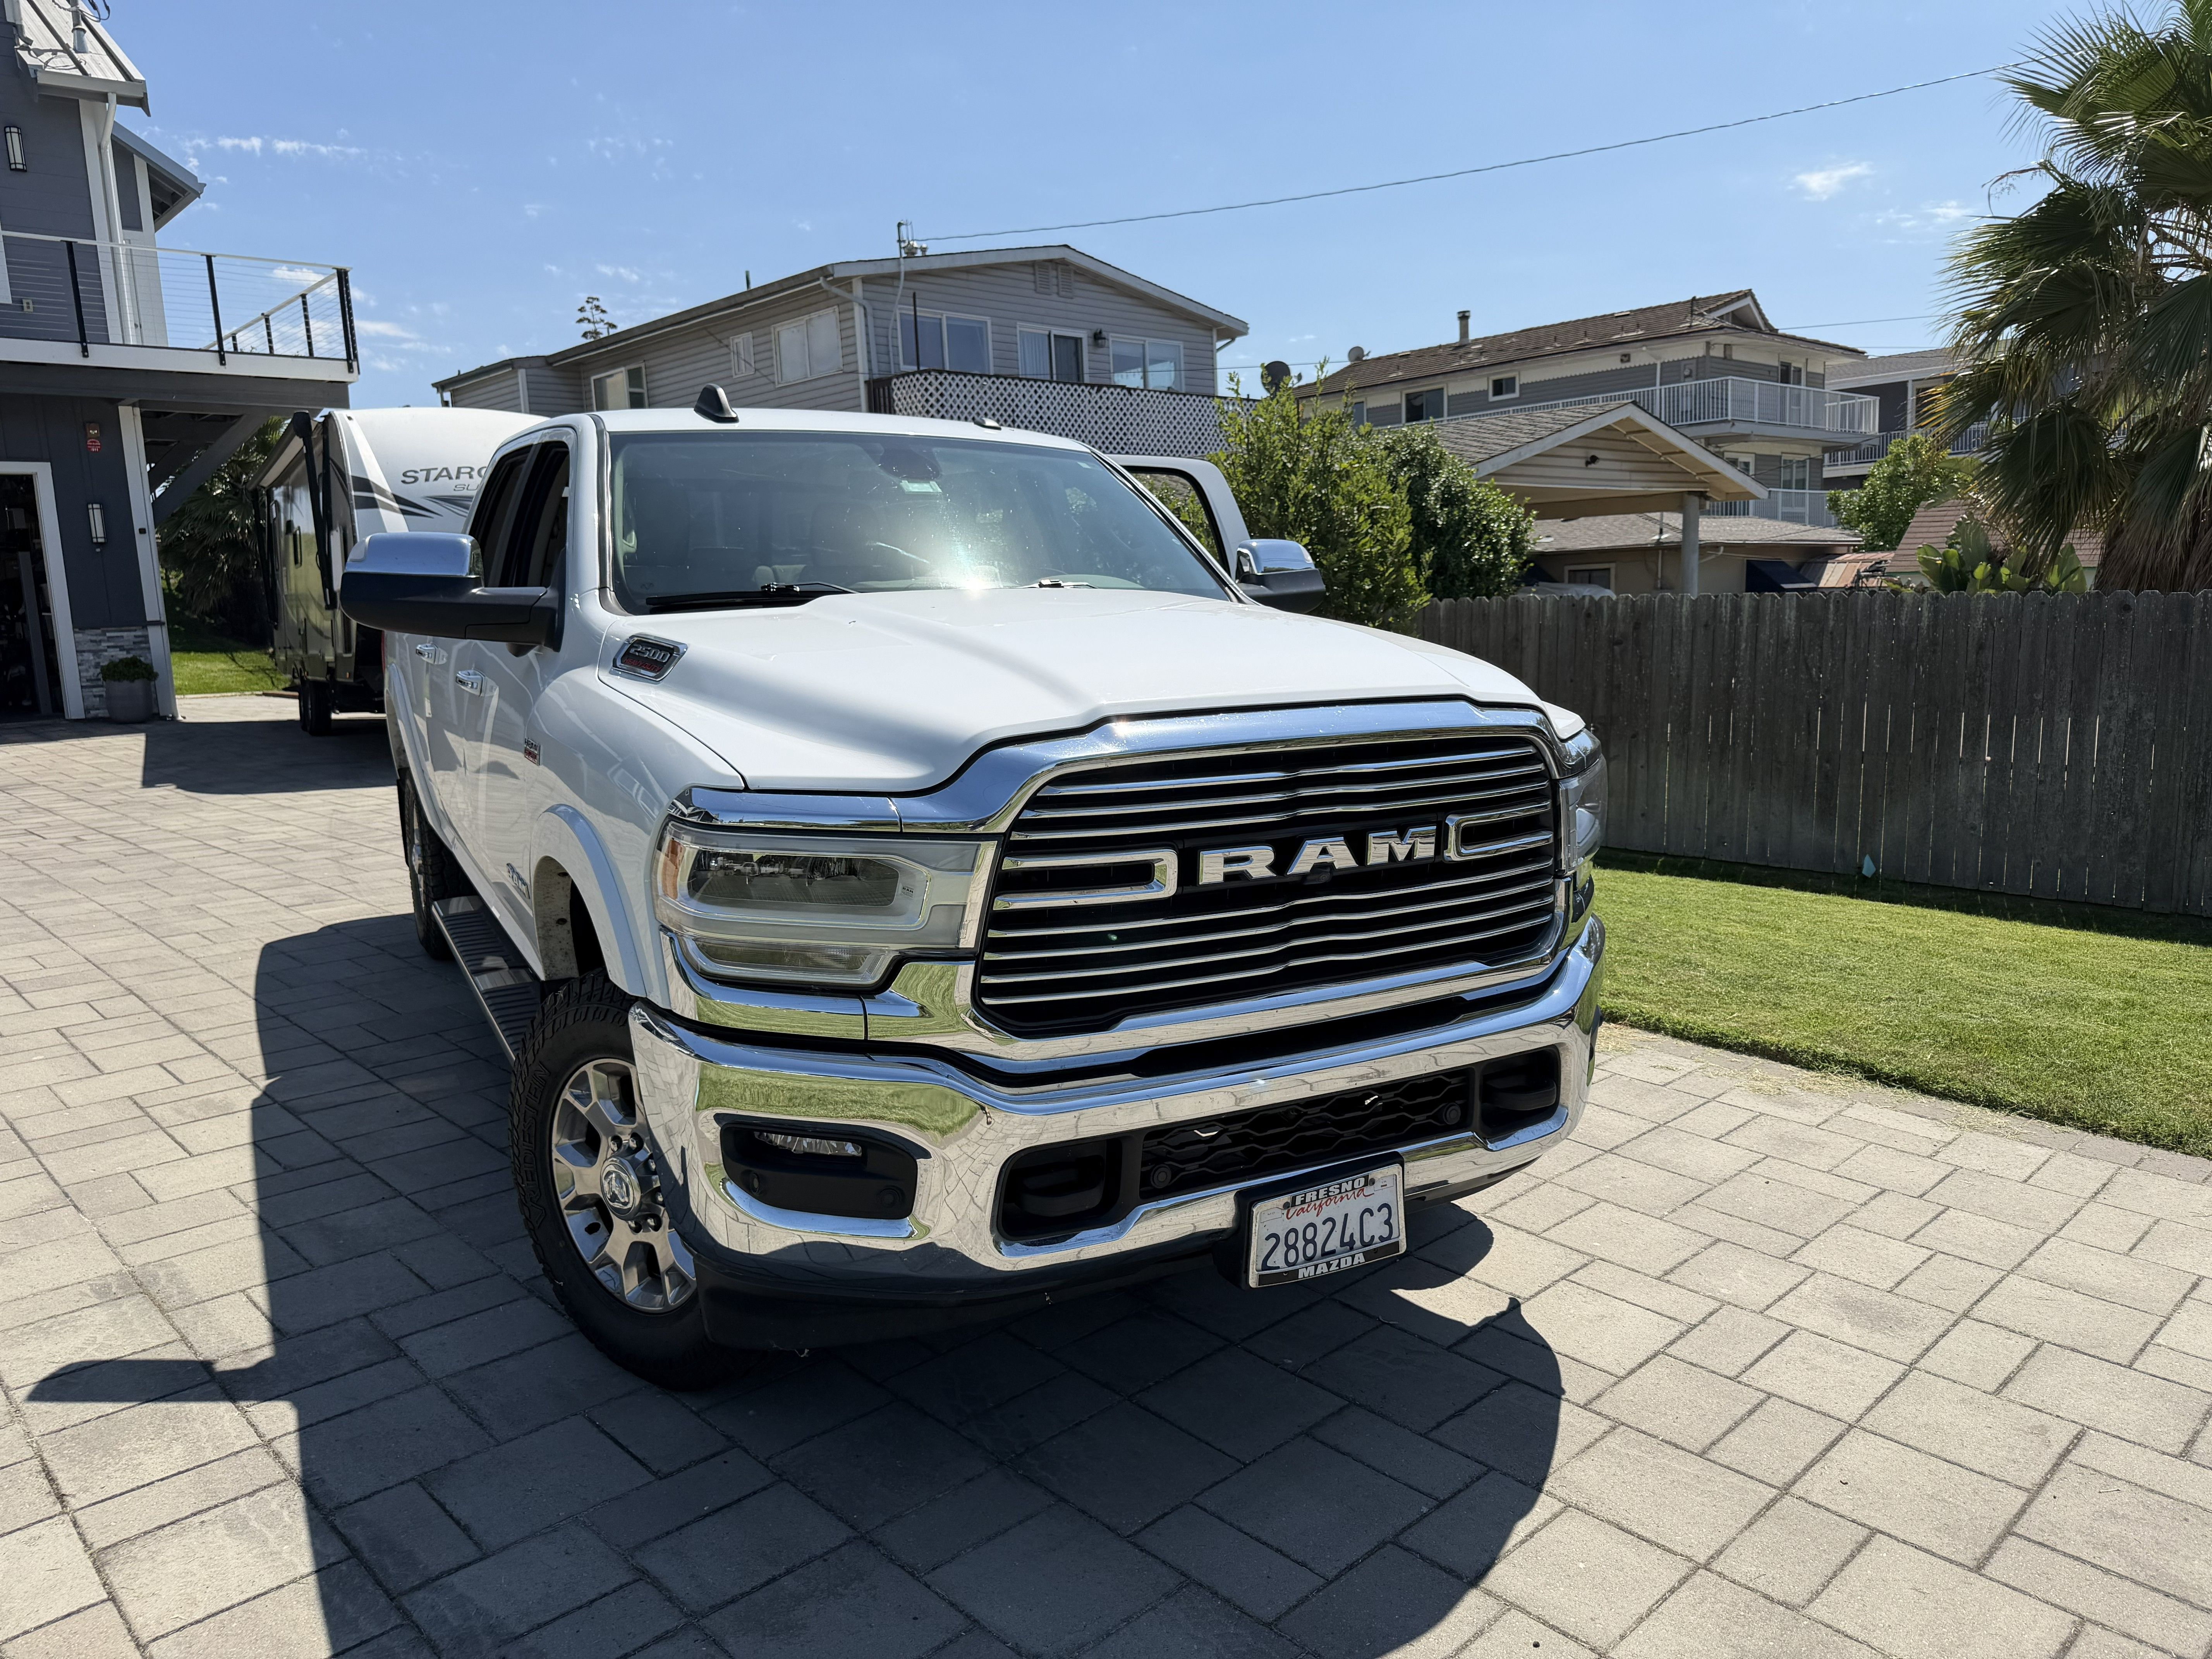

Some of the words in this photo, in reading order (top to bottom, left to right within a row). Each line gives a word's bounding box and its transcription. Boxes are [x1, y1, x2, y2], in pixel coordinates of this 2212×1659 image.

[623, 658, 644, 668] HEAVY
[642, 663, 663, 673] DUTY
[629, 644, 670, 662] 2500
[1198, 825, 1437, 886] RAM
[523, 1062, 550, 1229] VREDESTEIN
[1286, 1187, 1374, 1220] California
[1295, 1176, 1366, 1206] FRESNO
[1261, 1203, 1393, 1271] 28824C3
[1298, 1252, 1365, 1279] MAZDA
